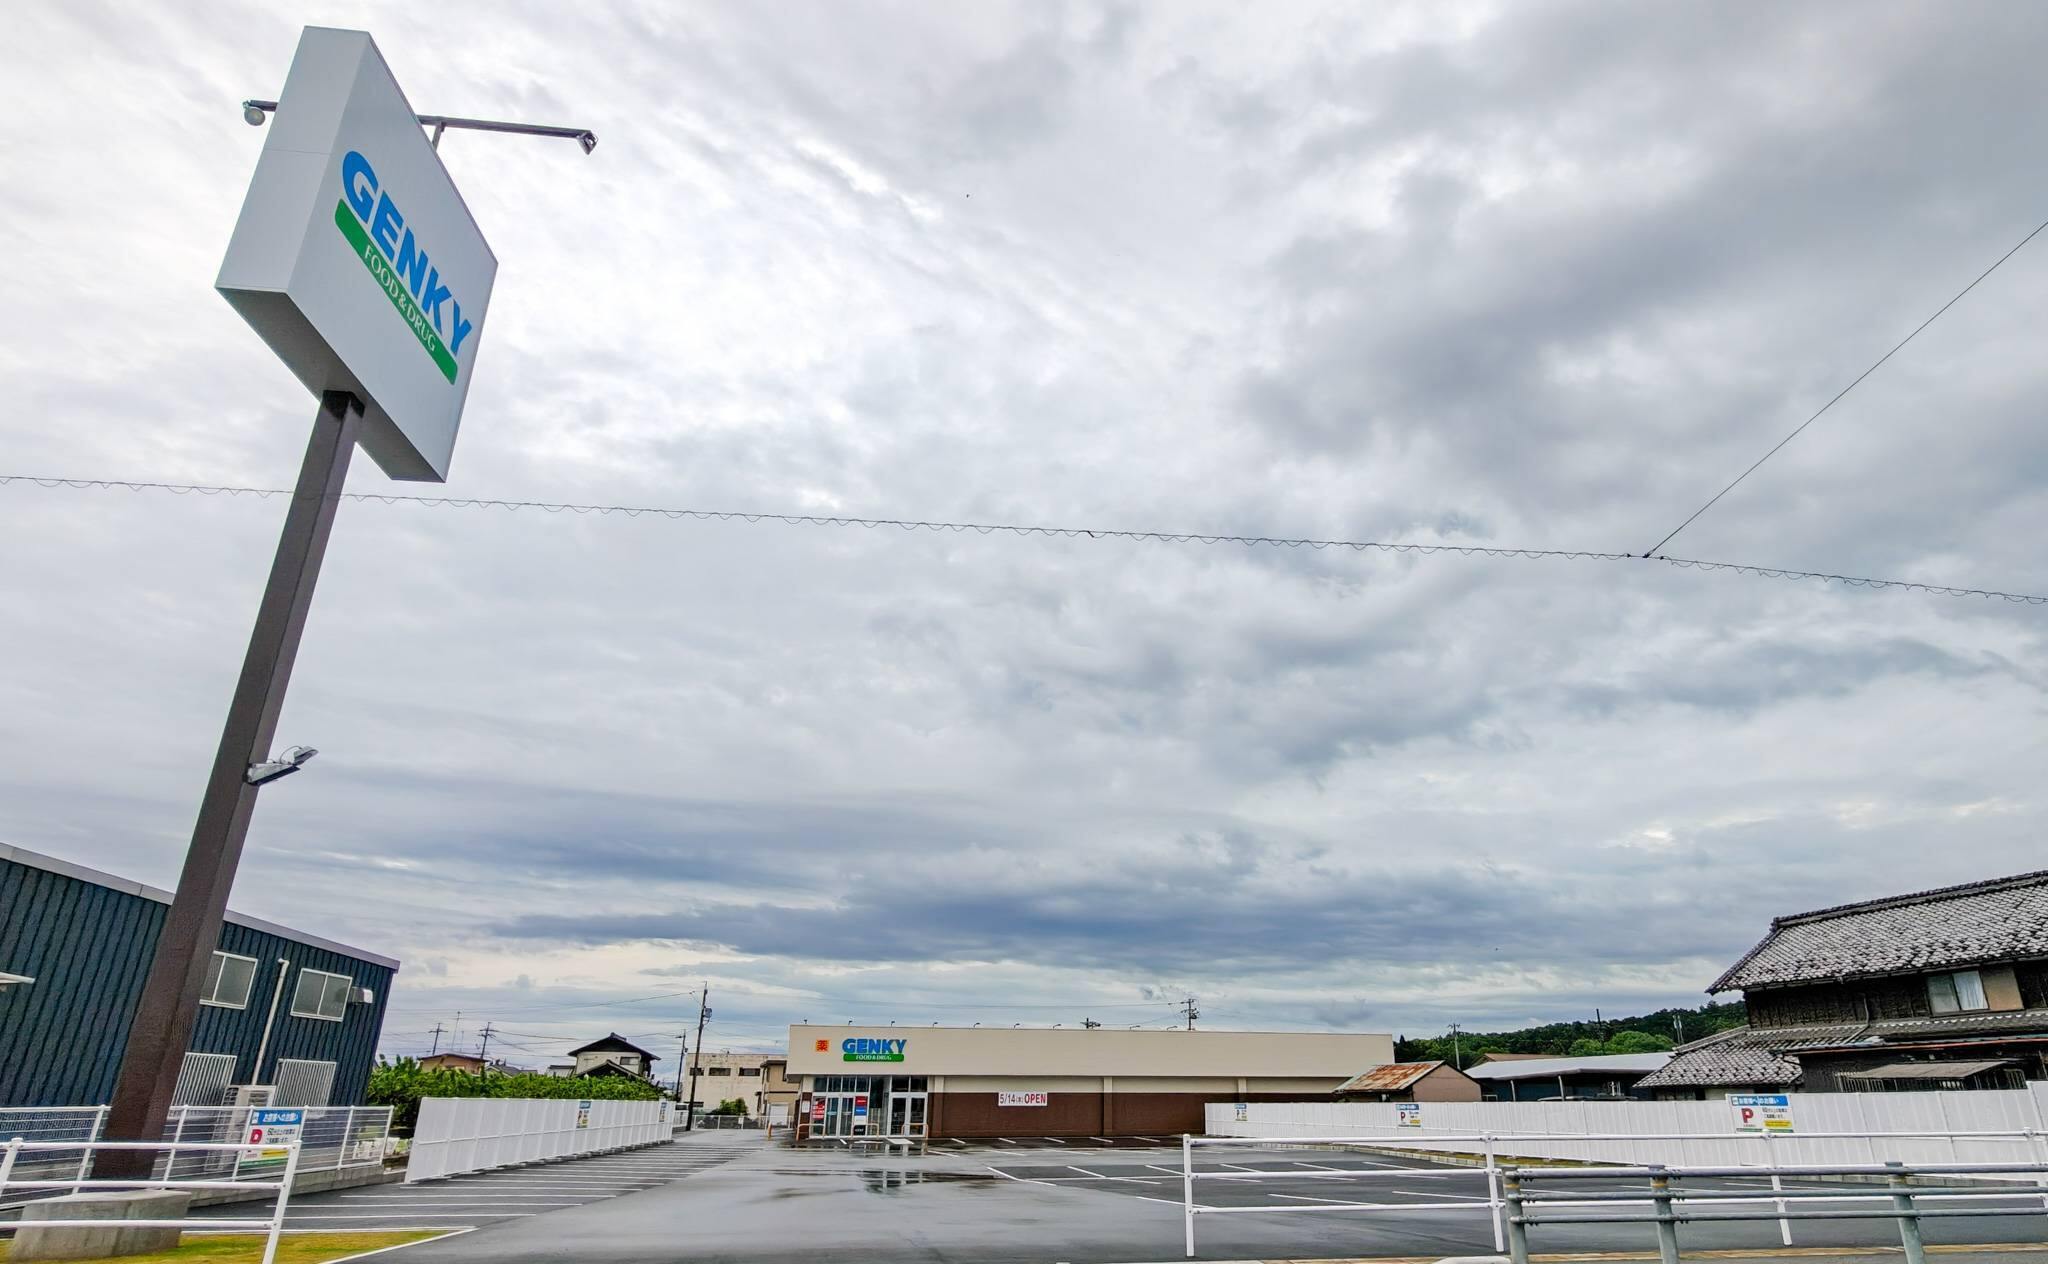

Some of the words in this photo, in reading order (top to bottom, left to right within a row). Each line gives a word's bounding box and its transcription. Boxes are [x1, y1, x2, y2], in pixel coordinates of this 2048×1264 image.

[342, 150, 472, 357] GENKY
[364, 244, 399, 298] FOOD
[406, 303, 436, 352] DRUG
[842, 1038, 907, 1054] GENKY
[1024, 1093, 1046, 1104] OPEN
[1741, 1107, 1754, 1123] P
